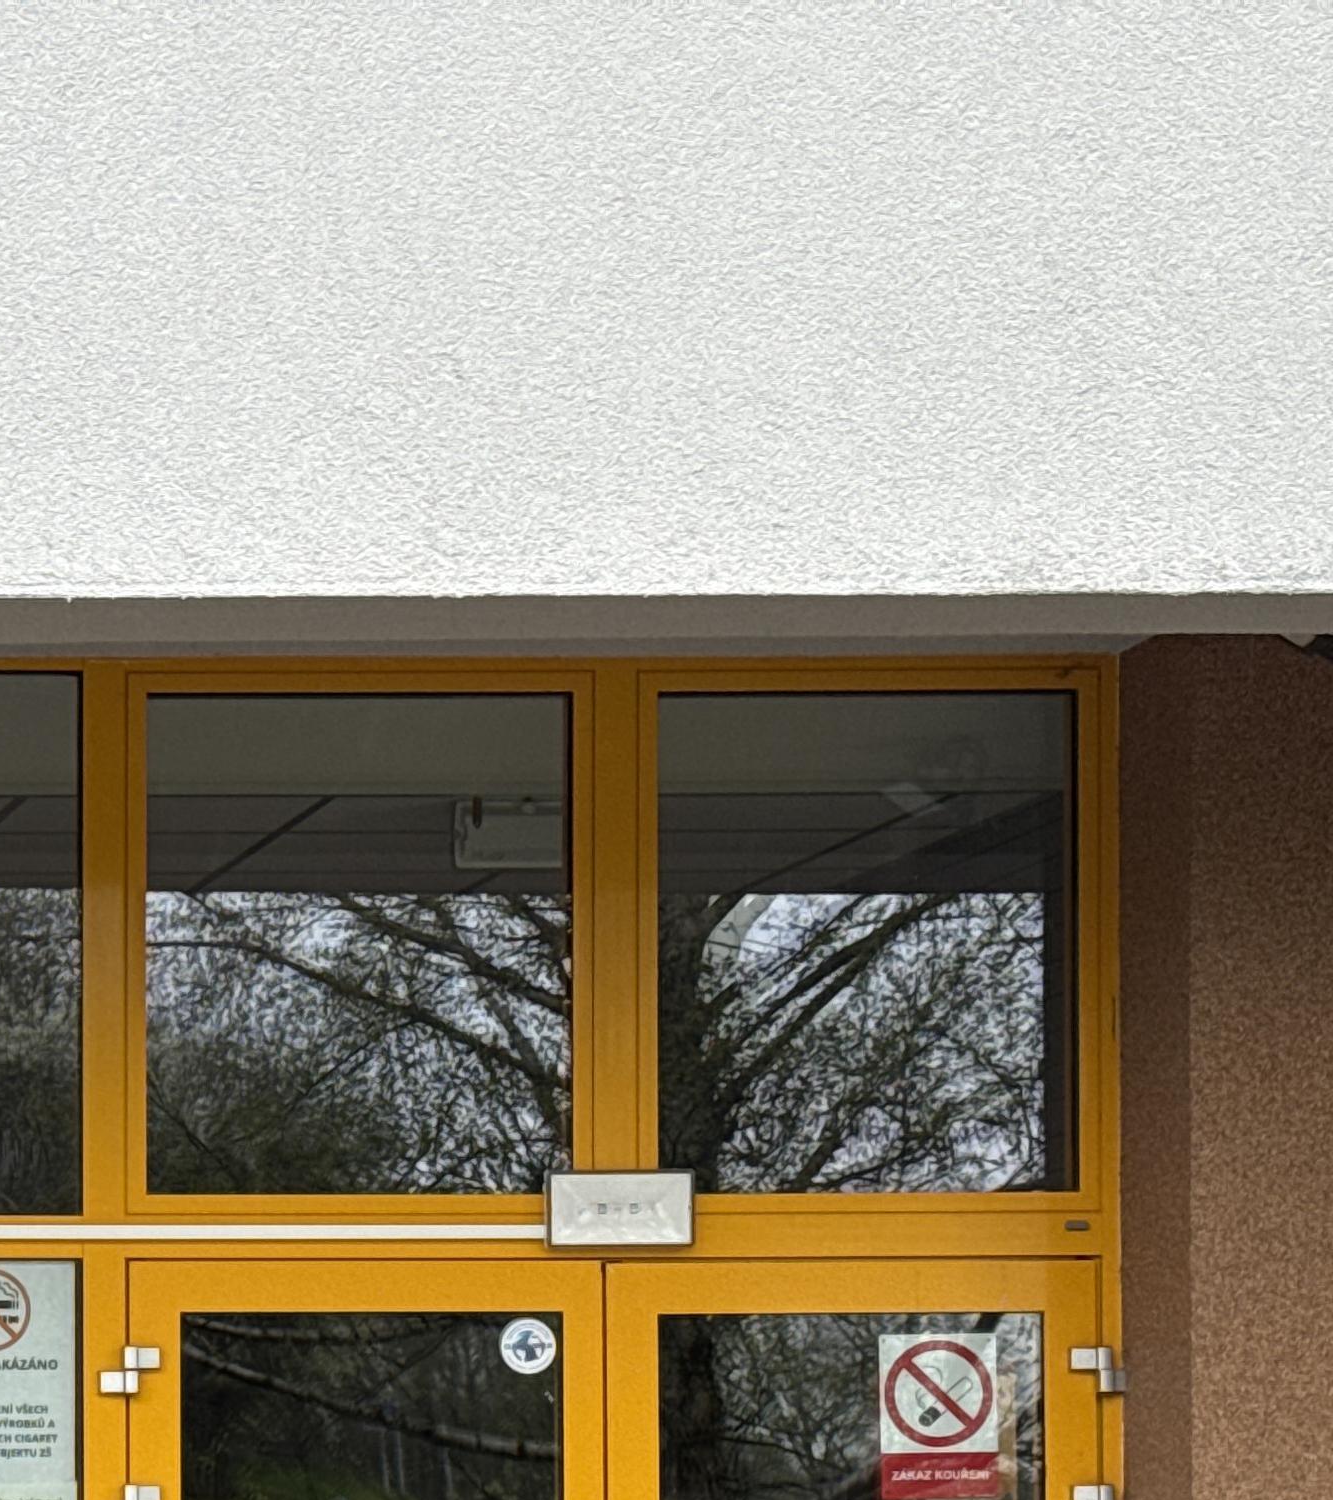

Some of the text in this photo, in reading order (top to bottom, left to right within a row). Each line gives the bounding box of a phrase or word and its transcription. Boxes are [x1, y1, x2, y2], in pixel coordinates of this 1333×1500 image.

[16, 1403, 49, 1415] VŠECH
[47, 1420, 56, 1429] A
[14, 1434, 58, 1444] CIGARET
[891, 1468, 990, 1481] ZÁKAZ KOUŘENÍ
